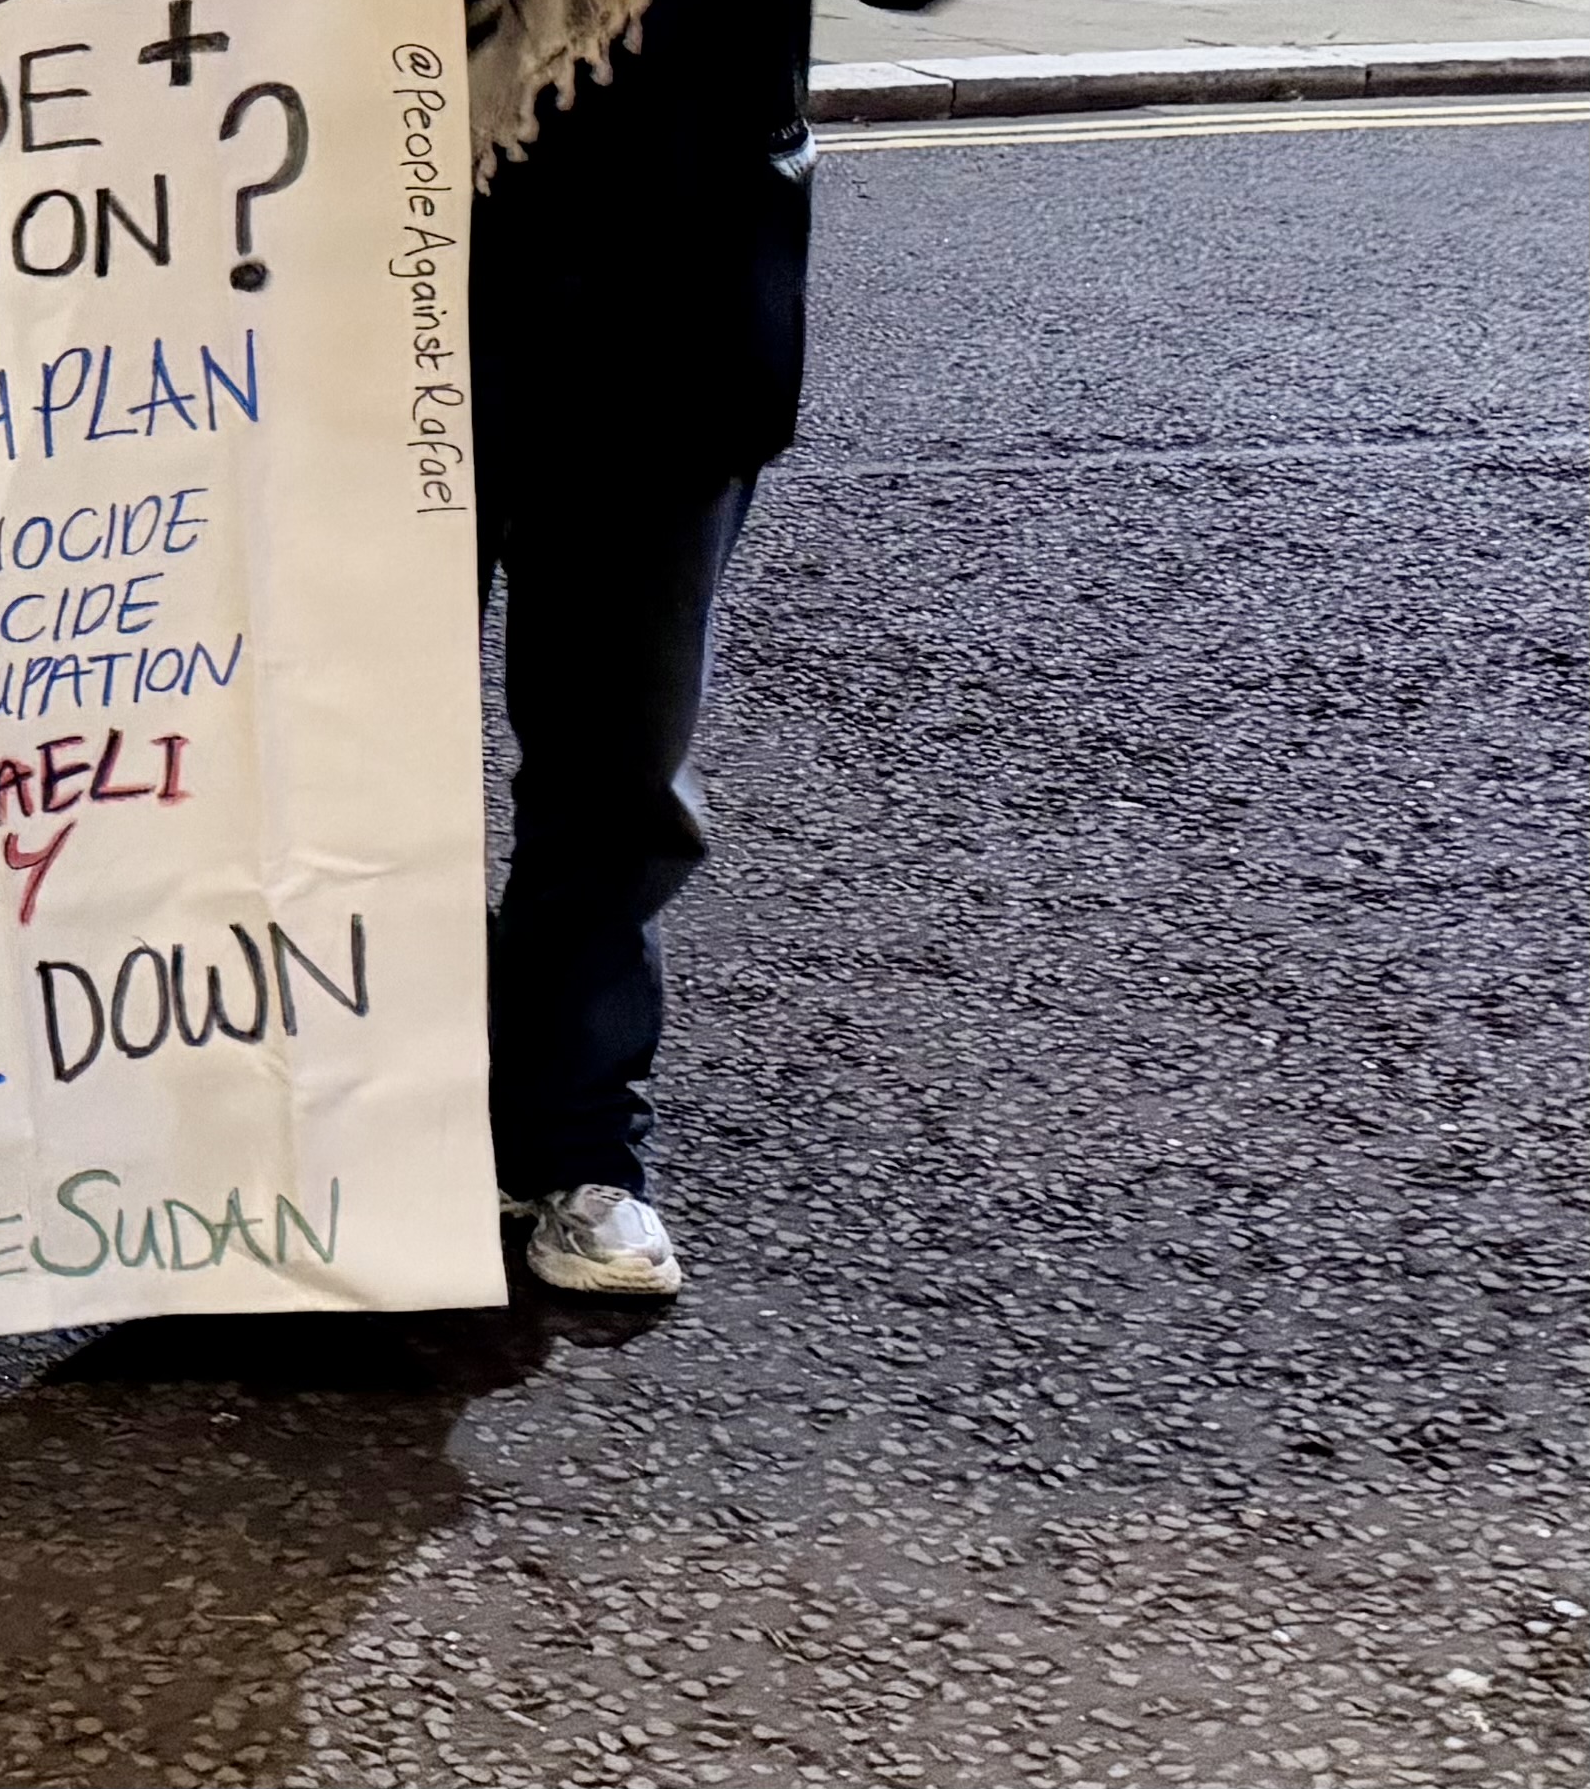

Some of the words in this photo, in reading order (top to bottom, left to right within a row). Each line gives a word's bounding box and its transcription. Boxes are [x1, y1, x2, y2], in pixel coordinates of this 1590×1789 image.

[39, 328, 260, 458] PLAN
[407, 384, 468, 514] Rafael
[37, 912, 373, 1086] DOWN
